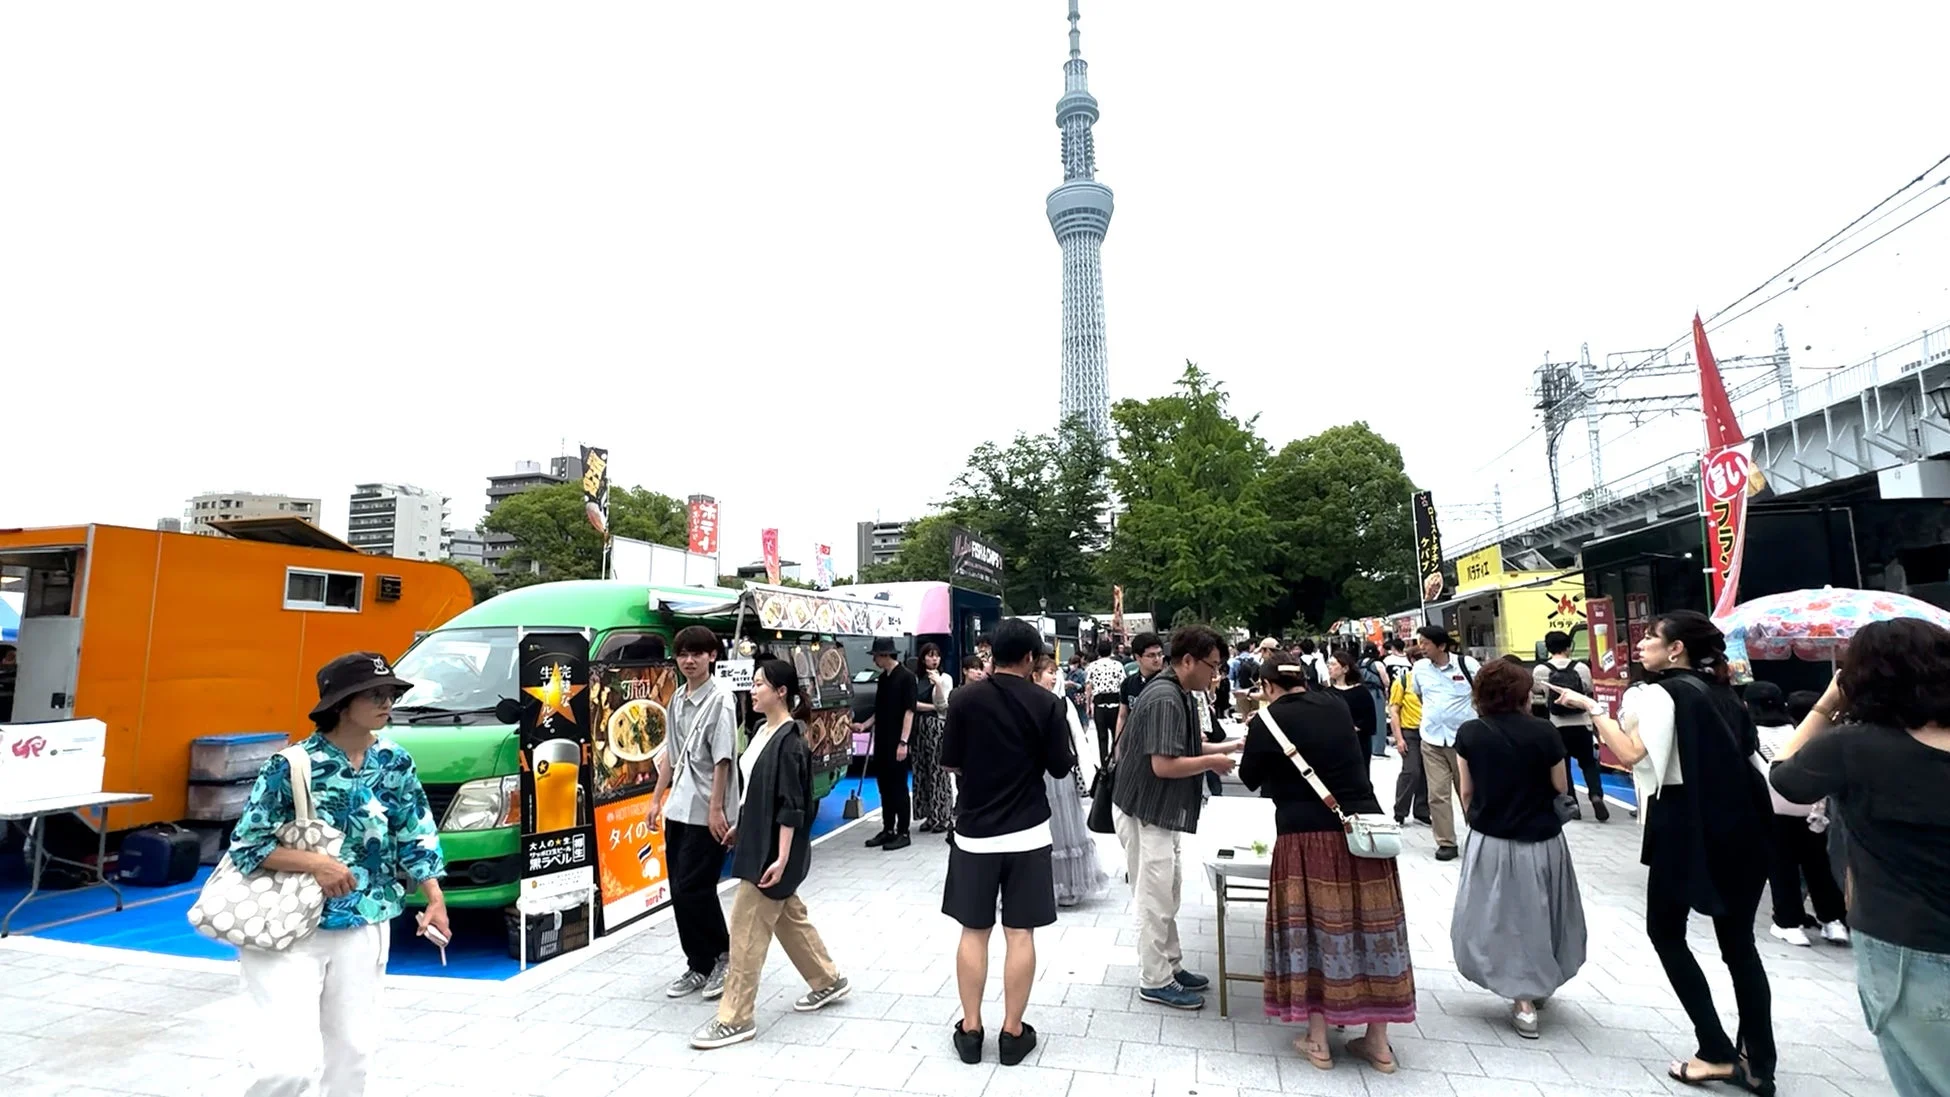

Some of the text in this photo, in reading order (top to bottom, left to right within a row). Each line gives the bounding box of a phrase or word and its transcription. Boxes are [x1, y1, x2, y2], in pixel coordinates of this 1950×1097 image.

[720, 668, 748, 678] 生ビール
[529, 853, 573, 871] 黒ラベル
